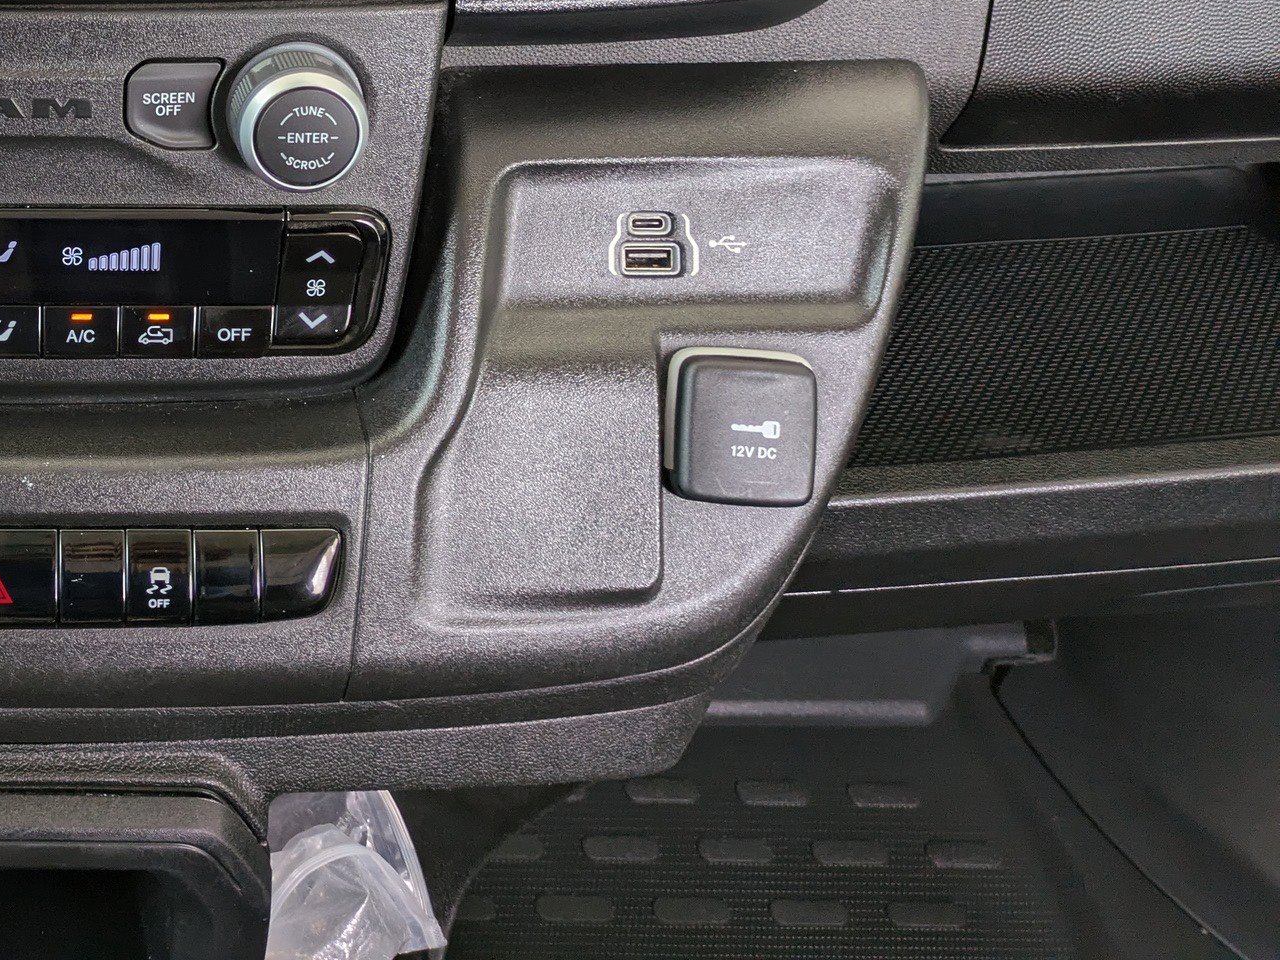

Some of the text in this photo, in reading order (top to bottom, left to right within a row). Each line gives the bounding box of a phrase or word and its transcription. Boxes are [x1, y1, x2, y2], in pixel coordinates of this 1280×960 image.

[141, 91, 196, 105] SCREEN
[155, 104, 182, 117] OFF
[292, 105, 327, 119] TUNE
[286, 131, 330, 145] ENTER
[285, 155, 331, 171] SCROLL
[65, 329, 96, 343] A/C
[216, 327, 252, 342] OFF
[730, 445, 778, 460] 12V DC
[147, 597, 171, 610] OFF
